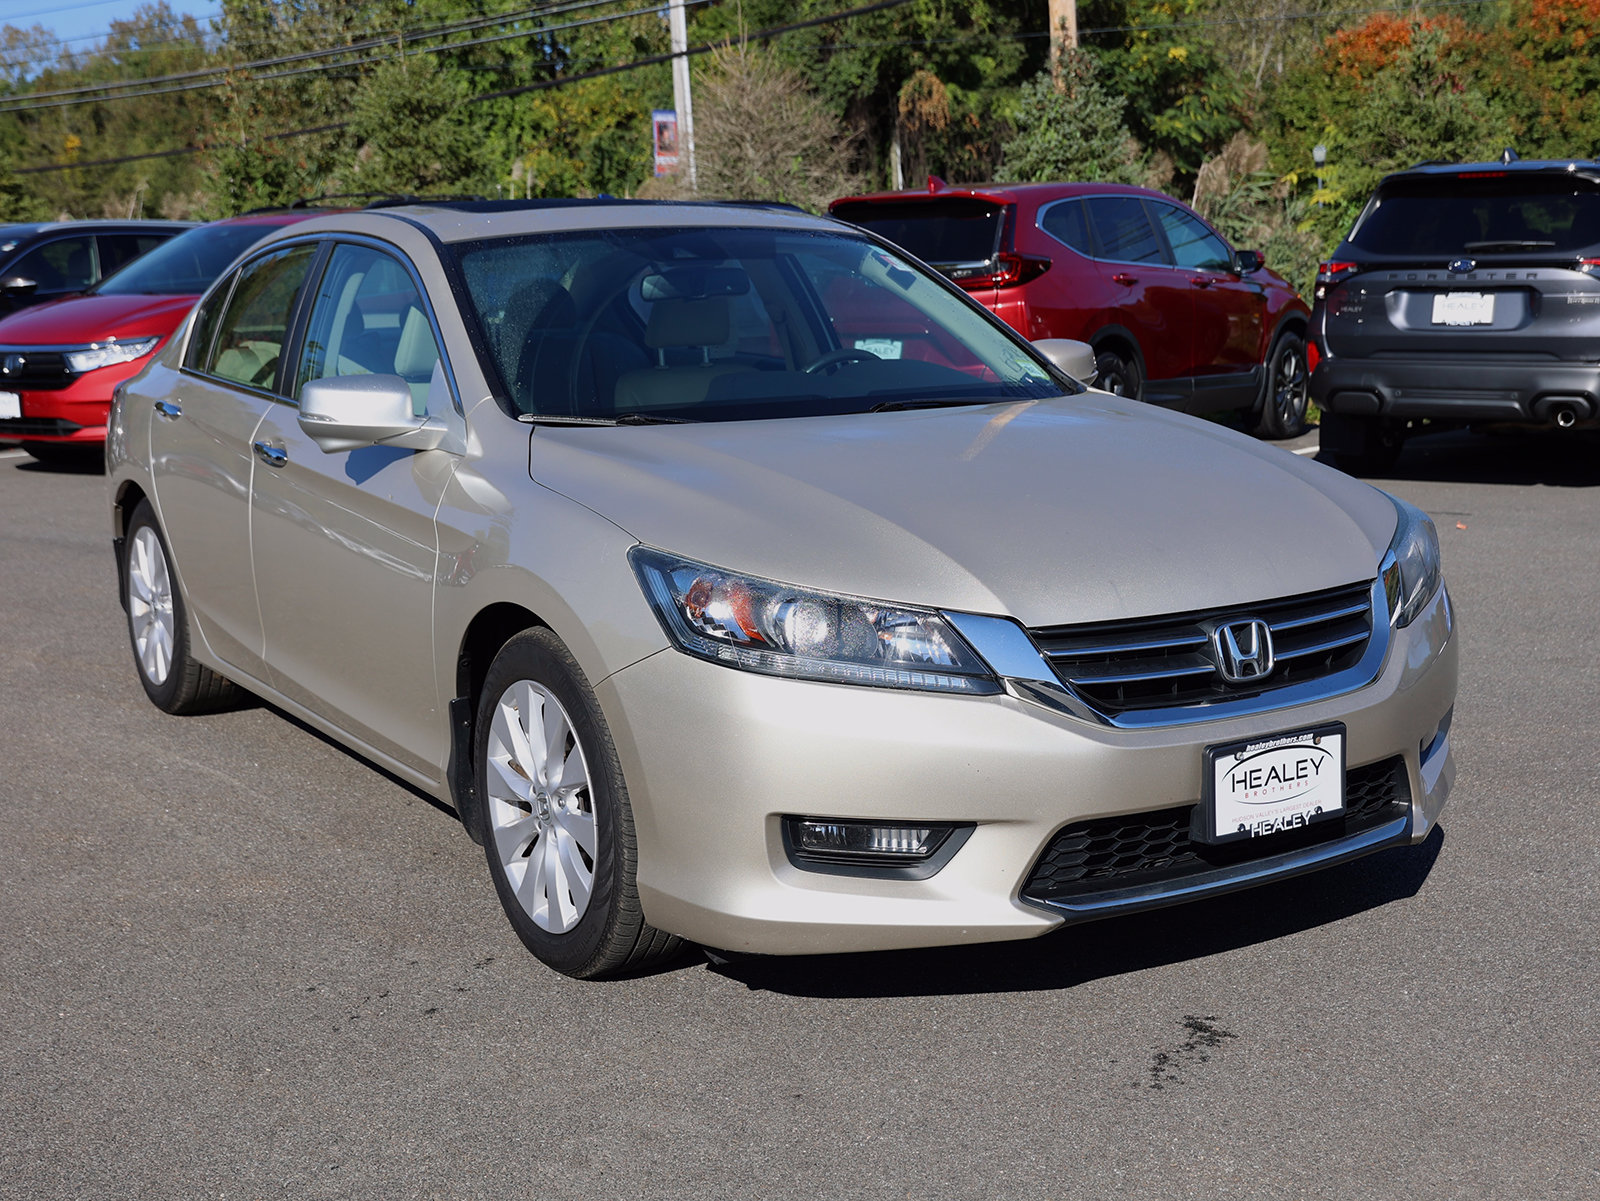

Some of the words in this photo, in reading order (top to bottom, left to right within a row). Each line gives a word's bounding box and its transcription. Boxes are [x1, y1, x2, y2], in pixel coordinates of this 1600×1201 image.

[1387, 272, 1537, 281] FORESTER
[1442, 302, 1485, 310] HEALEY
[1246, 733, 1314, 752] healeybrothers.com
[1232, 755, 1325, 792] HEALEY
[1244, 780, 1309, 799] BROTHERS
[1250, 810, 1312, 838] HEALEY
